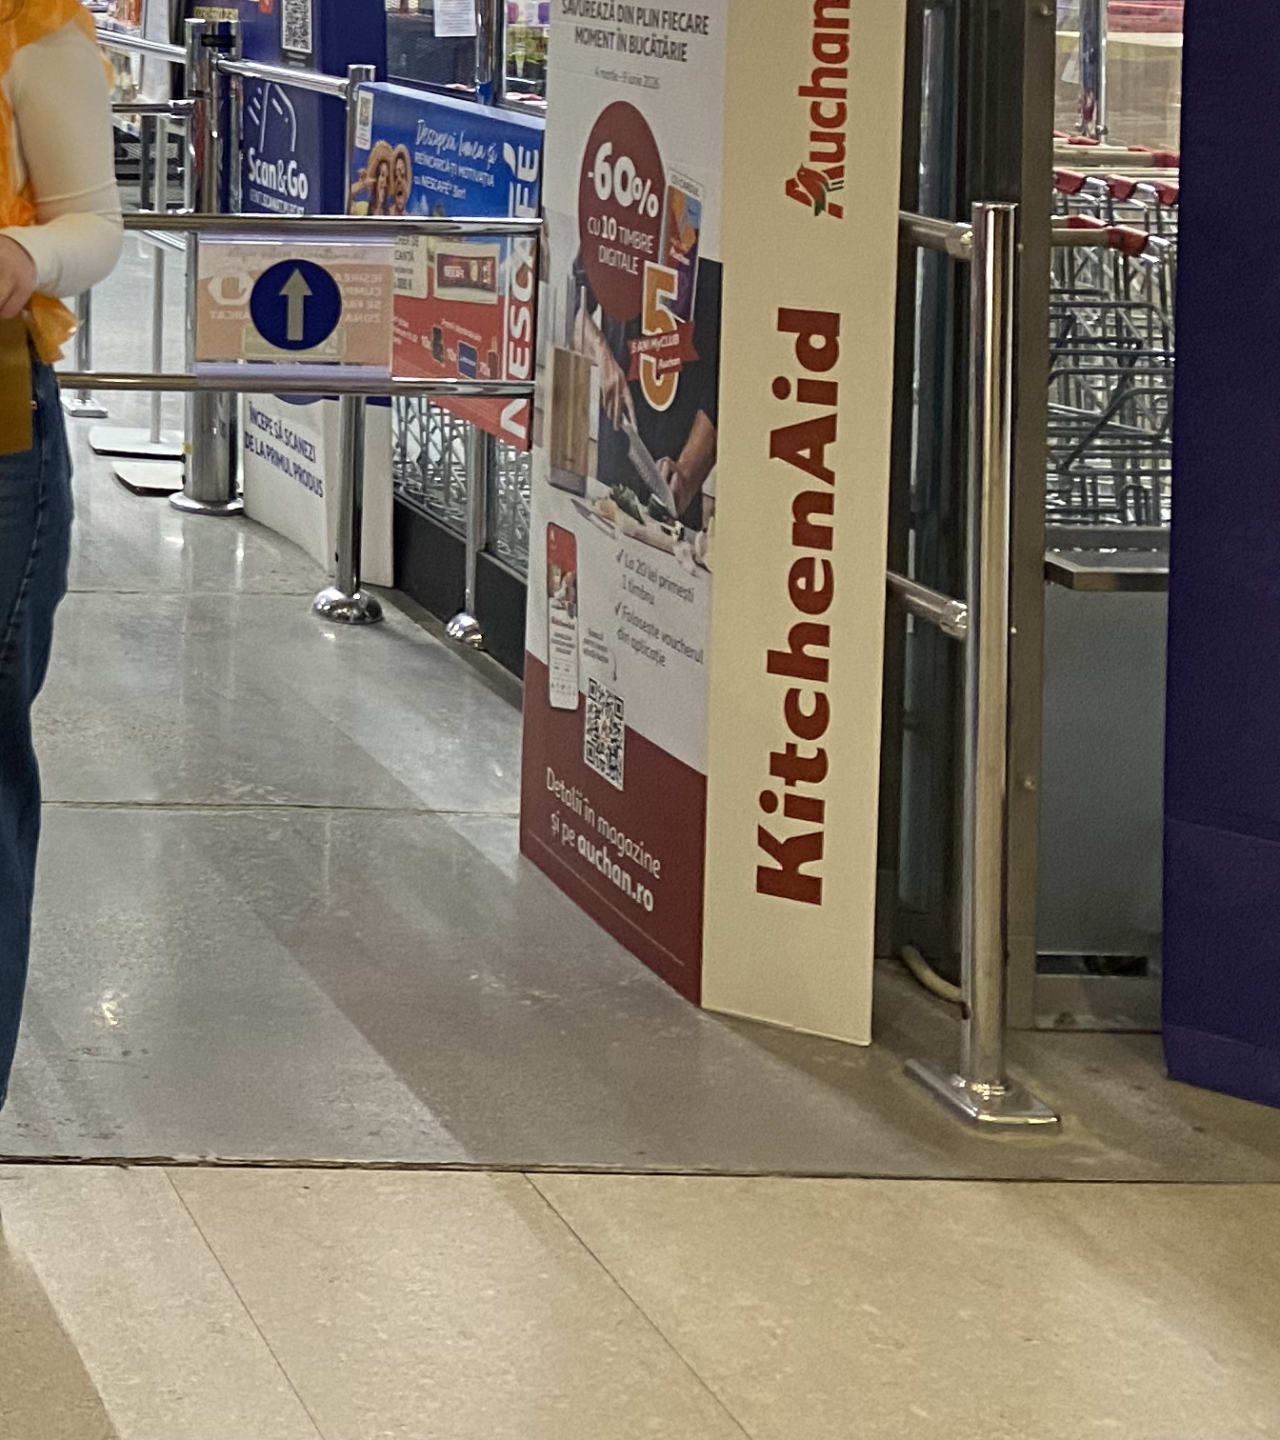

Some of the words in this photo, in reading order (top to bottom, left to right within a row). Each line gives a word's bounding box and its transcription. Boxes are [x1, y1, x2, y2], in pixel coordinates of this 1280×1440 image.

[574, 26, 615, 51] MOMENT
[616, 27, 628, 53] ÎN
[629, 33, 688, 63] BUCĂTĂRIE
[617, 3, 635, 25] DIN
[636, 6, 660, 30] PLIN
[661, 10, 710, 36] FIECARE
[248, 147, 308, 200] Scan&Go
[587, 141, 659, 218] -60%
[587, 216, 600, 236] CU
[601, 214, 617, 241] 10
[618, 225, 654, 255] TIMBRE
[598, 243, 639, 276] DIGITALE
[244, 430, 254, 453] DE
[255, 437, 266, 458] LA
[293, 461, 323, 498] PRODUS
[283, 428, 317, 464] SCANEZI
[755, 306, 841, 906] KitchenAid
[545, 766, 584, 816] Detalii
[584, 796, 596, 825] în
[597, 813, 662, 881] magazine
[550, 809, 560, 839] și
[561, 819, 576, 848] pe
[577, 832, 655, 913] auchan.ro
